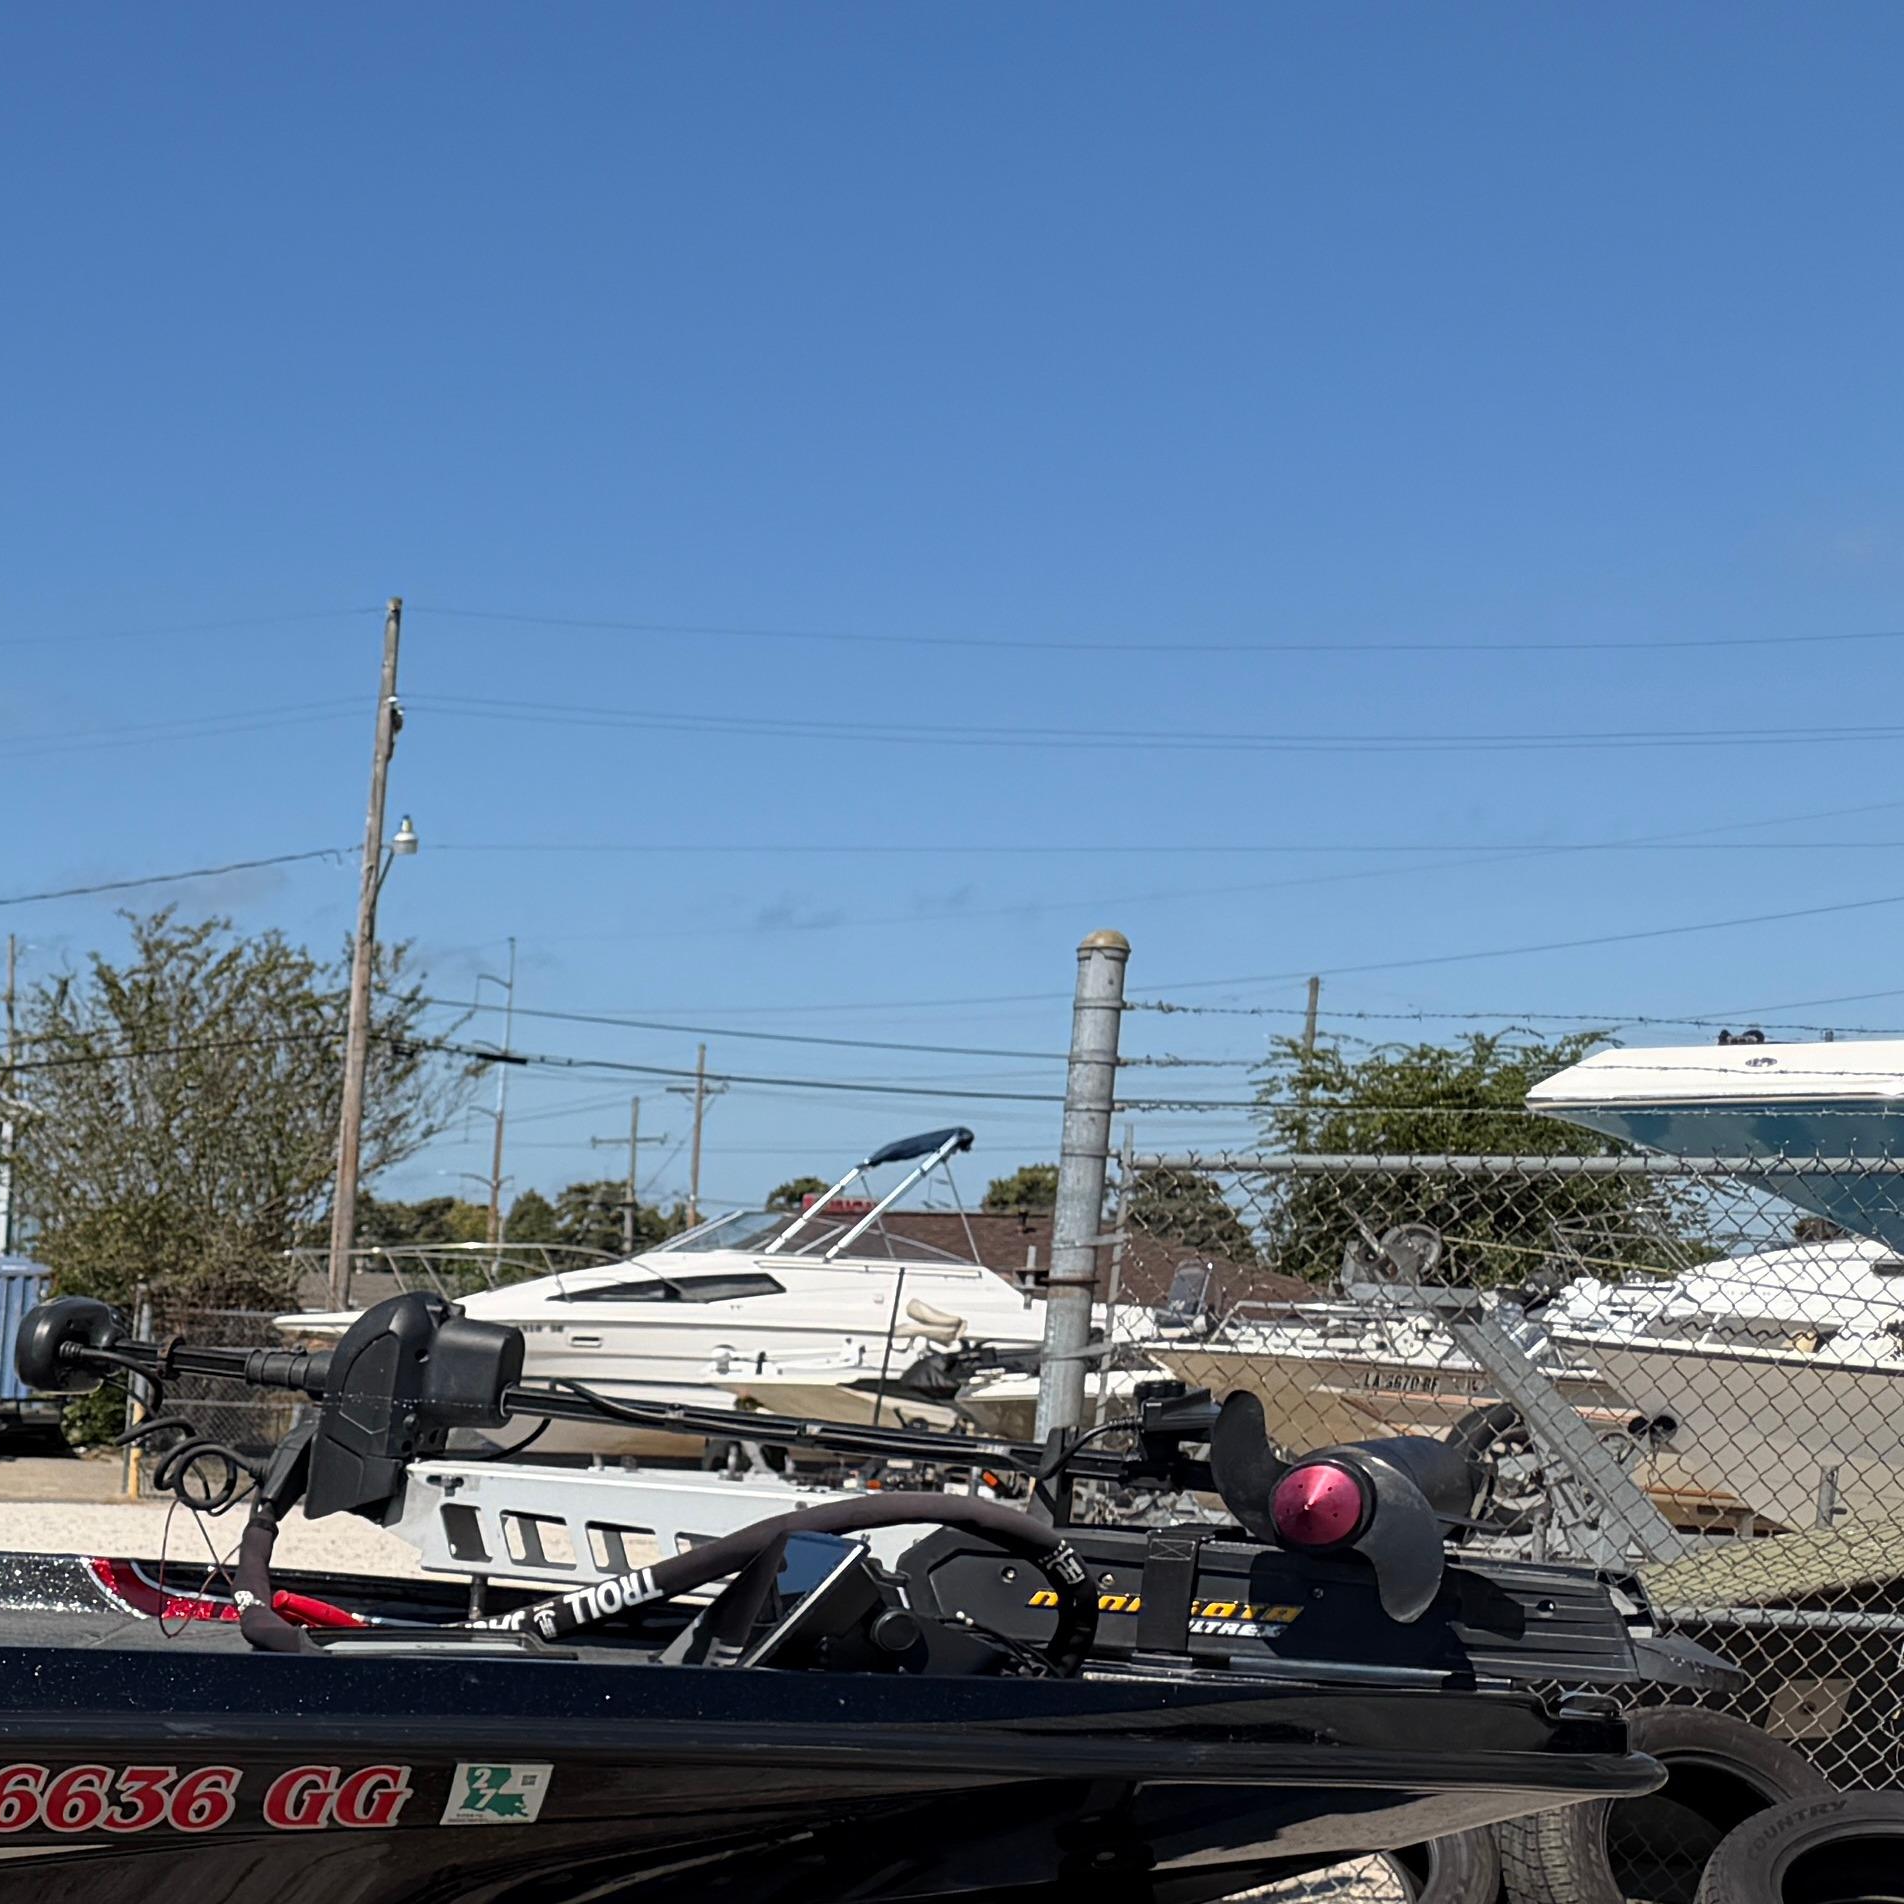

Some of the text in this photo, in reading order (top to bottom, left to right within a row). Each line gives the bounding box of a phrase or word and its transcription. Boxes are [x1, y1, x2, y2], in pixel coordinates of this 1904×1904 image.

[1364, 1372, 1380, 1388] LA
[563, 1567, 664, 1624] TROLL
[262, 1764, 413, 1831] GG
[1747, 1800, 1848, 1861] COUNTRY
